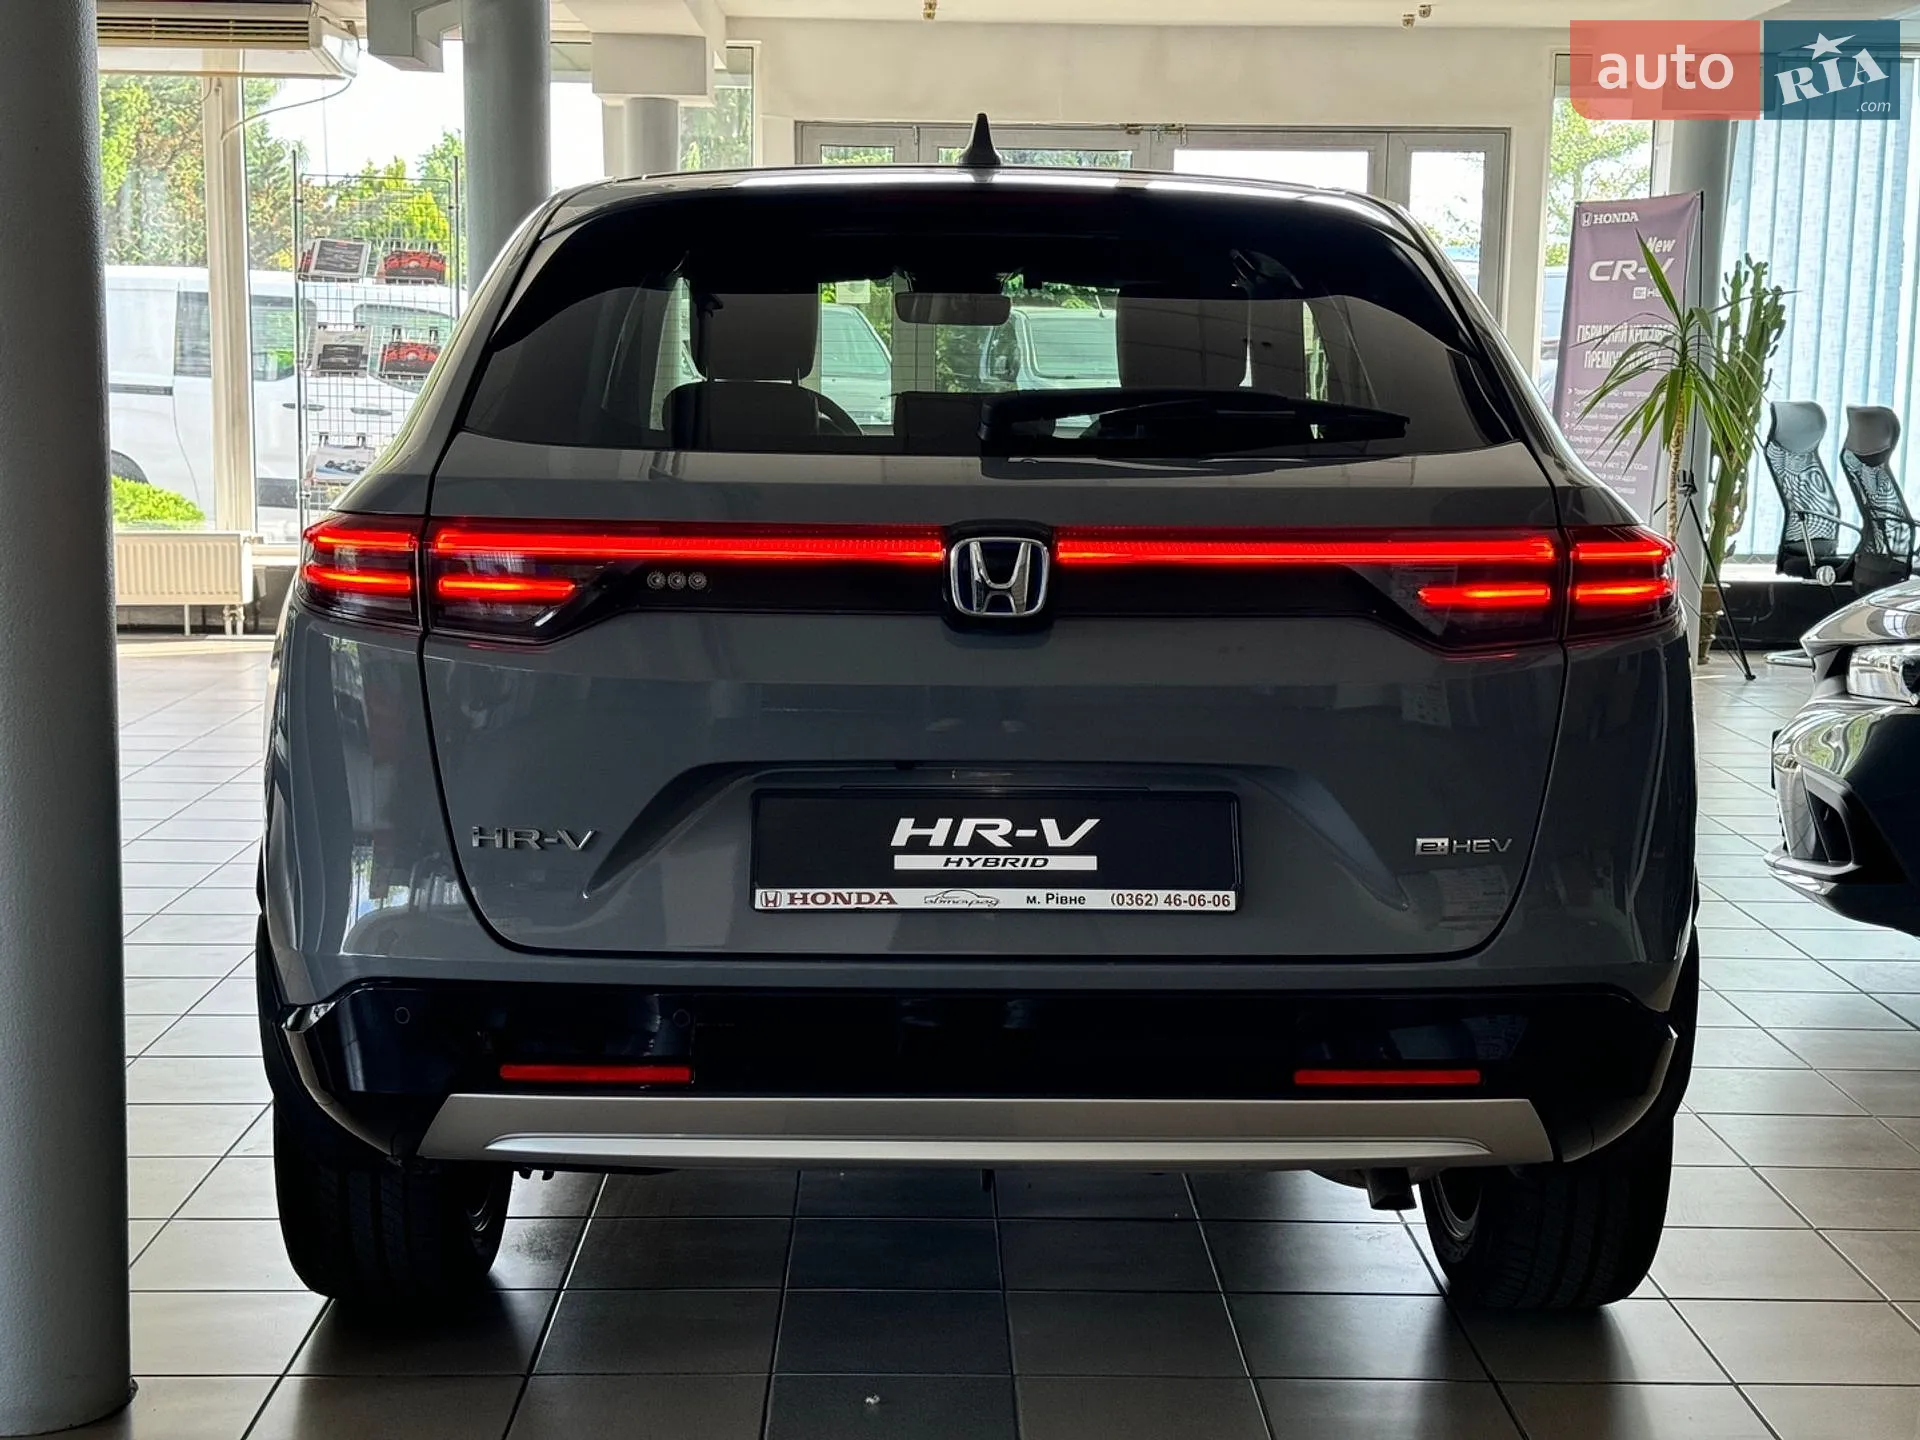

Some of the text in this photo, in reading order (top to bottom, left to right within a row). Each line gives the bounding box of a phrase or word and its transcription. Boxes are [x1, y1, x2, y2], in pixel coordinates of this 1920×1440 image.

[1593, 211, 1640, 225] HONDA
[1645, 236, 1676, 254] New
[472, 826, 597, 851] HR-V
[891, 818, 1101, 848] HR-V
[942, 857, 1050, 869] HYBRID
[787, 892, 899, 906] HONDA
[1026, 893, 1231, 908] м. Рівне (0362) 46-06-06
